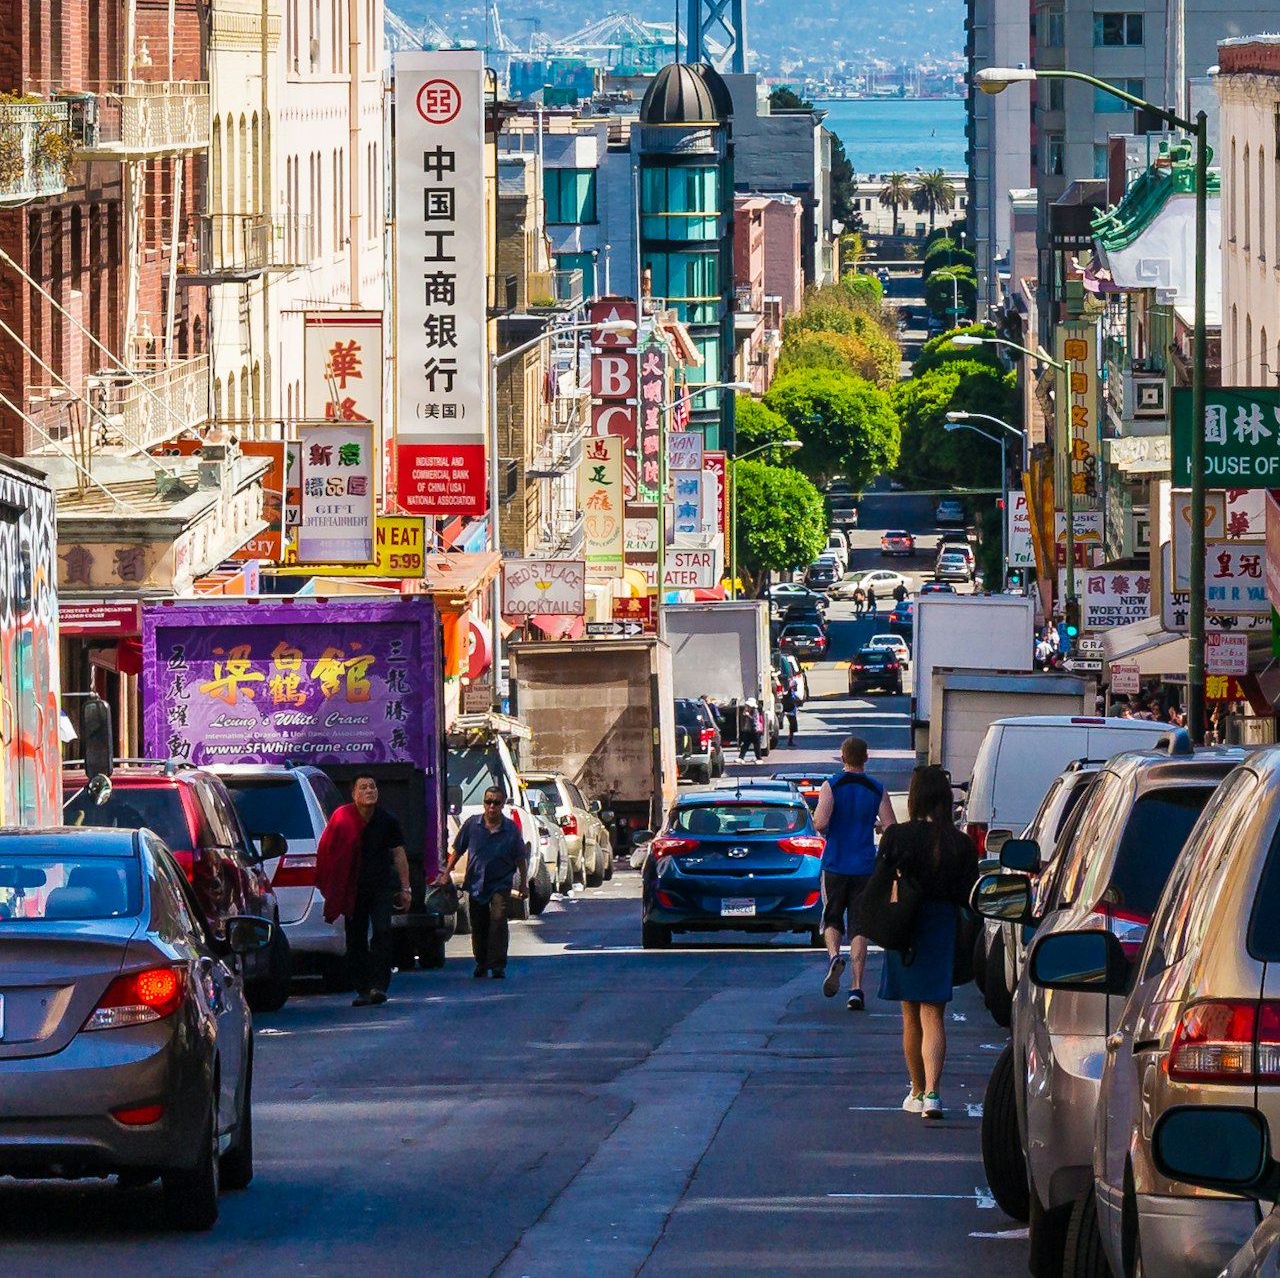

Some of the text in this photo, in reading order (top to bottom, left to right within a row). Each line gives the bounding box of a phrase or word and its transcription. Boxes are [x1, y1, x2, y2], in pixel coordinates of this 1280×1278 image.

[423, 145, 459, 393] 中国工商银行
[415, 457, 464, 467] INDUSTRIAL AND
[1254, 456, 1279, 475] OF
[452, 469, 469, 480] BANK
[417, 482, 425, 492] OF
[407, 495, 476, 505] NATIONAL ASSOCIATION
[315, 504, 356, 515] GIFT
[391, 527, 420, 545] EAT
[389, 553, 421, 569] 5.99
[675, 553, 712, 567] STAR
[506, 563, 582, 590] RED'S PLACE
[506, 600, 582, 614] COCKTAILS
[1121, 596, 1147, 606] NEW
[1088, 606, 1148, 615] WOEY LOY
[1208, 634, 1247, 646] NO PARKING
[208, 711, 370, 730] Leung's White Crane
[204, 731, 254, 740] International
[254, 731, 282, 740] Dragon
[282, 730, 290, 738] &
[331, 729, 375, 738] Association
[204, 740, 375, 756] www.SFWhiteCrane.com
